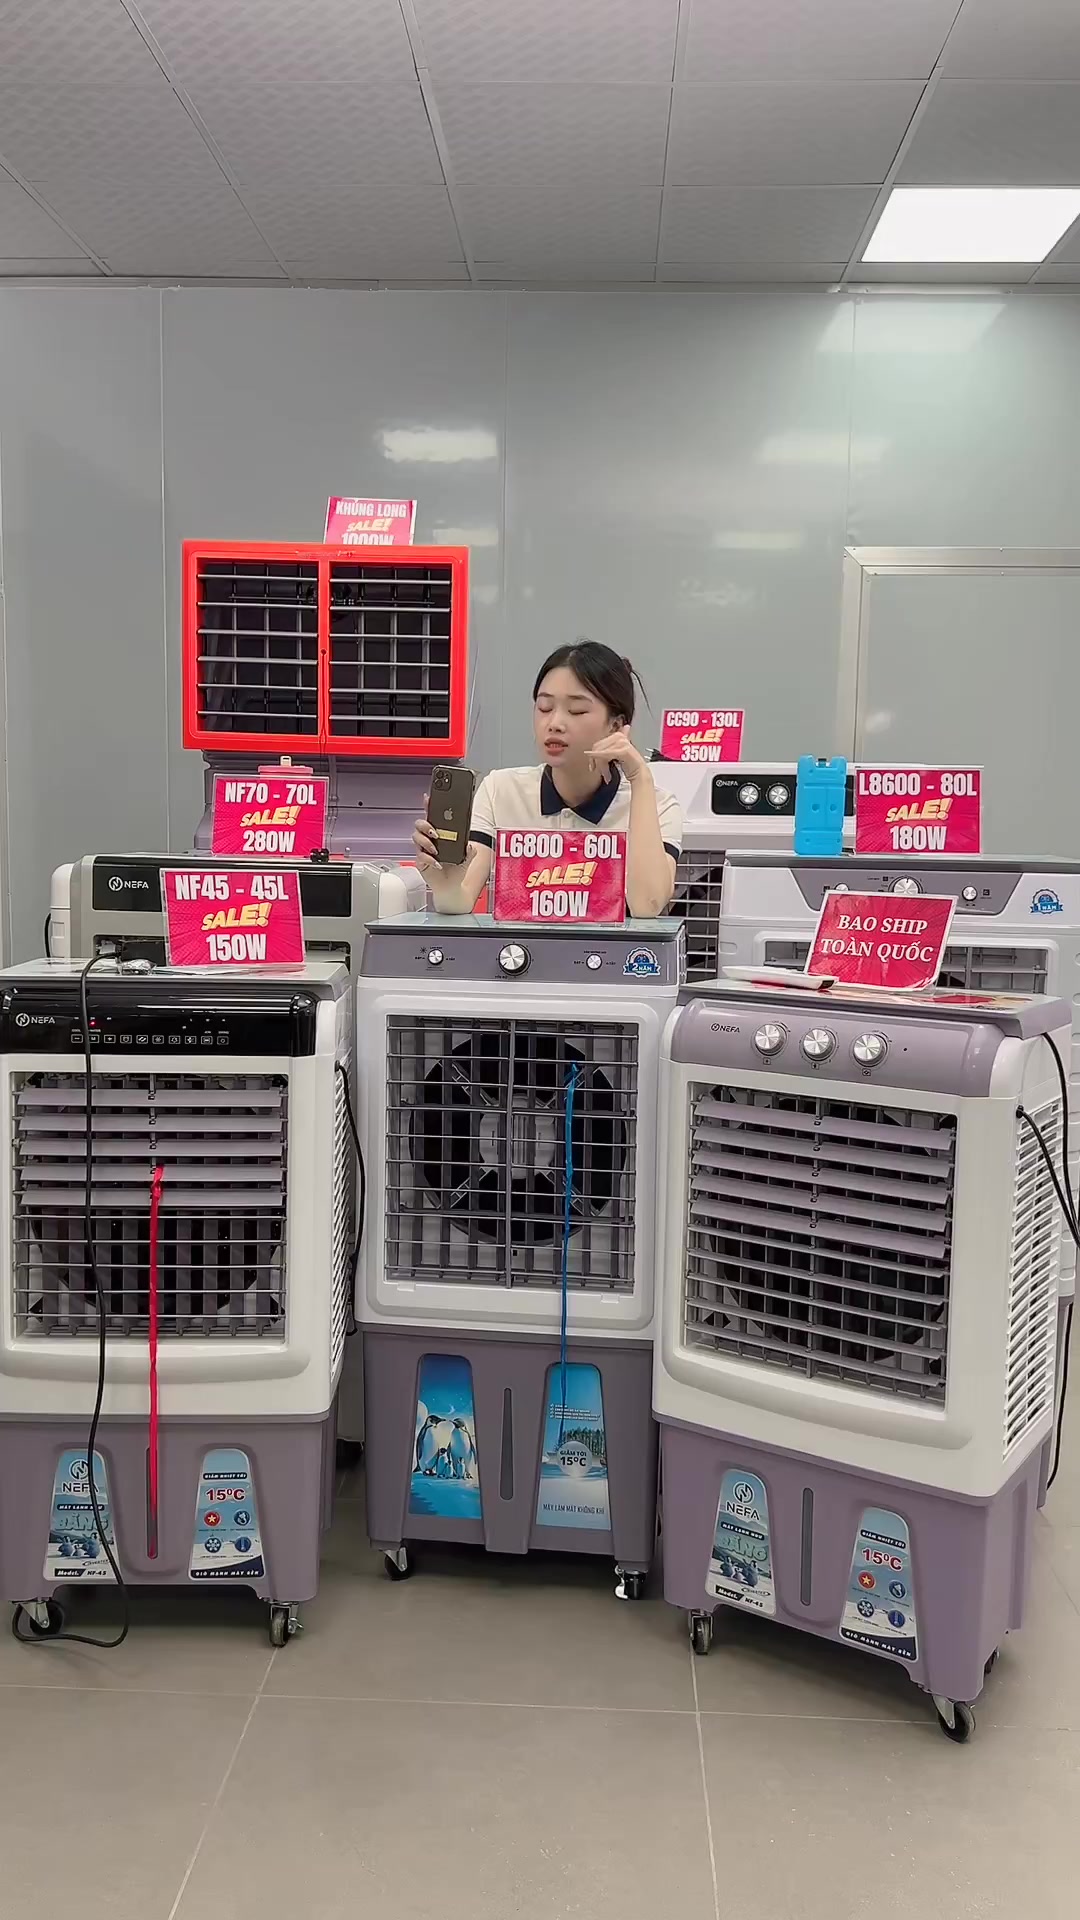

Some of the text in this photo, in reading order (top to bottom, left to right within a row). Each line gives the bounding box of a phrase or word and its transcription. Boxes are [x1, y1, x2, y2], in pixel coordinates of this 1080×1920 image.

[377, 504, 407, 518] LONG
[346, 518, 393, 532] SALE!
[666, 712, 699, 727] CC90
[711, 712, 740, 728] 130L
[680, 728, 724, 744] SALE!
[681, 745, 722, 762] 350W
[225, 782, 268, 804] NF70
[286, 784, 317, 805] 70L
[859, 772, 920, 796] L8600
[940, 773, 977, 796] 80L
[240, 805, 301, 827] SALE!
[885, 798, 953, 823] SALE!
[243, 830, 296, 852] 280W
[500, 833, 563, 858] L6800
[584, 834, 621, 859] 60L
[890, 826, 947, 850] 180W
[124, 880, 149, 889] NEFA
[525, 861, 598, 888] SALE!
[175, 875, 229, 900] NF45
[250, 876, 289, 900] 45L
[530, 890, 589, 917] 160W
[201, 902, 272, 930] SALE!
[837, 914, 928, 934] BAO SHIP
[206, 934, 266, 961] 150W
[820, 937, 934, 962] TOÀN QUỐC
[726, 1501, 759, 1520] NEFA
